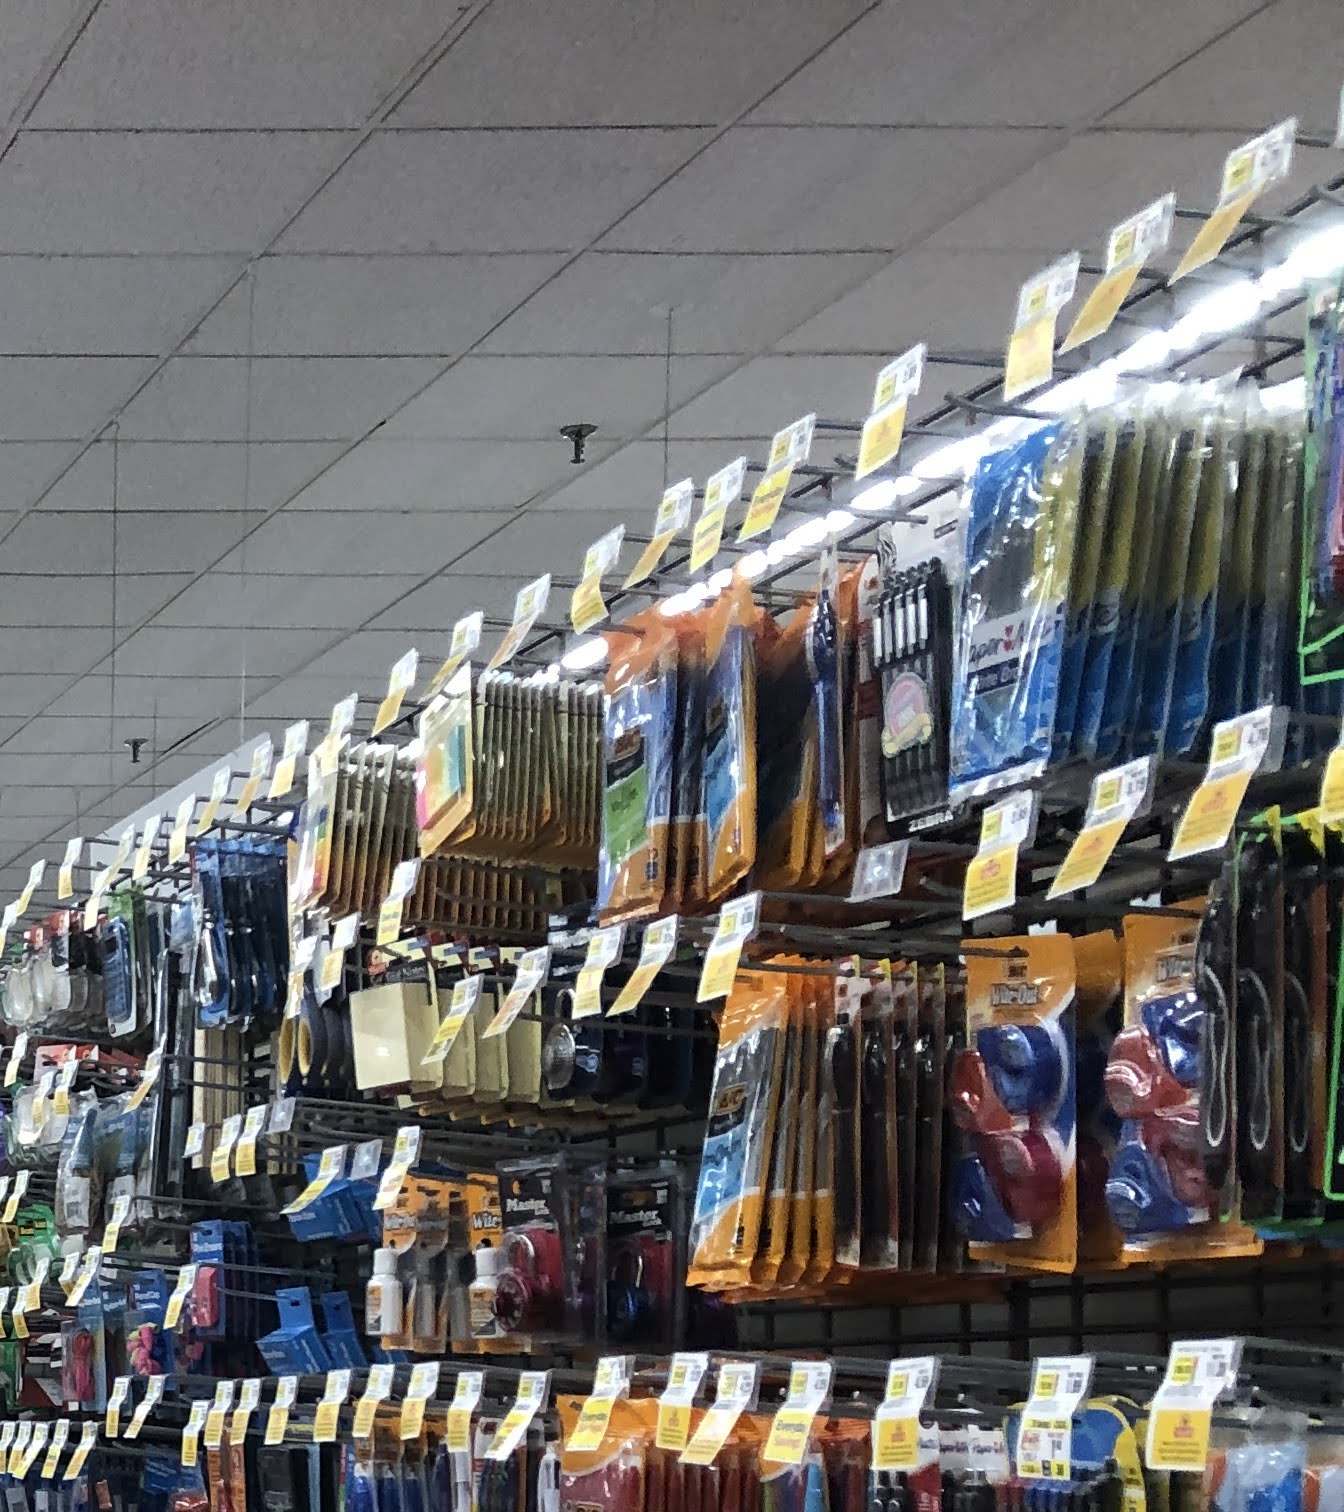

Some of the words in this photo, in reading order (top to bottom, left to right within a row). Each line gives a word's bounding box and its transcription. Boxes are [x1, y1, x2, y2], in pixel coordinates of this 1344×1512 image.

[909, 808, 954, 832] ZEBRA
[505, 1197, 547, 1214] Master
[611, 1208, 659, 1225] Master
